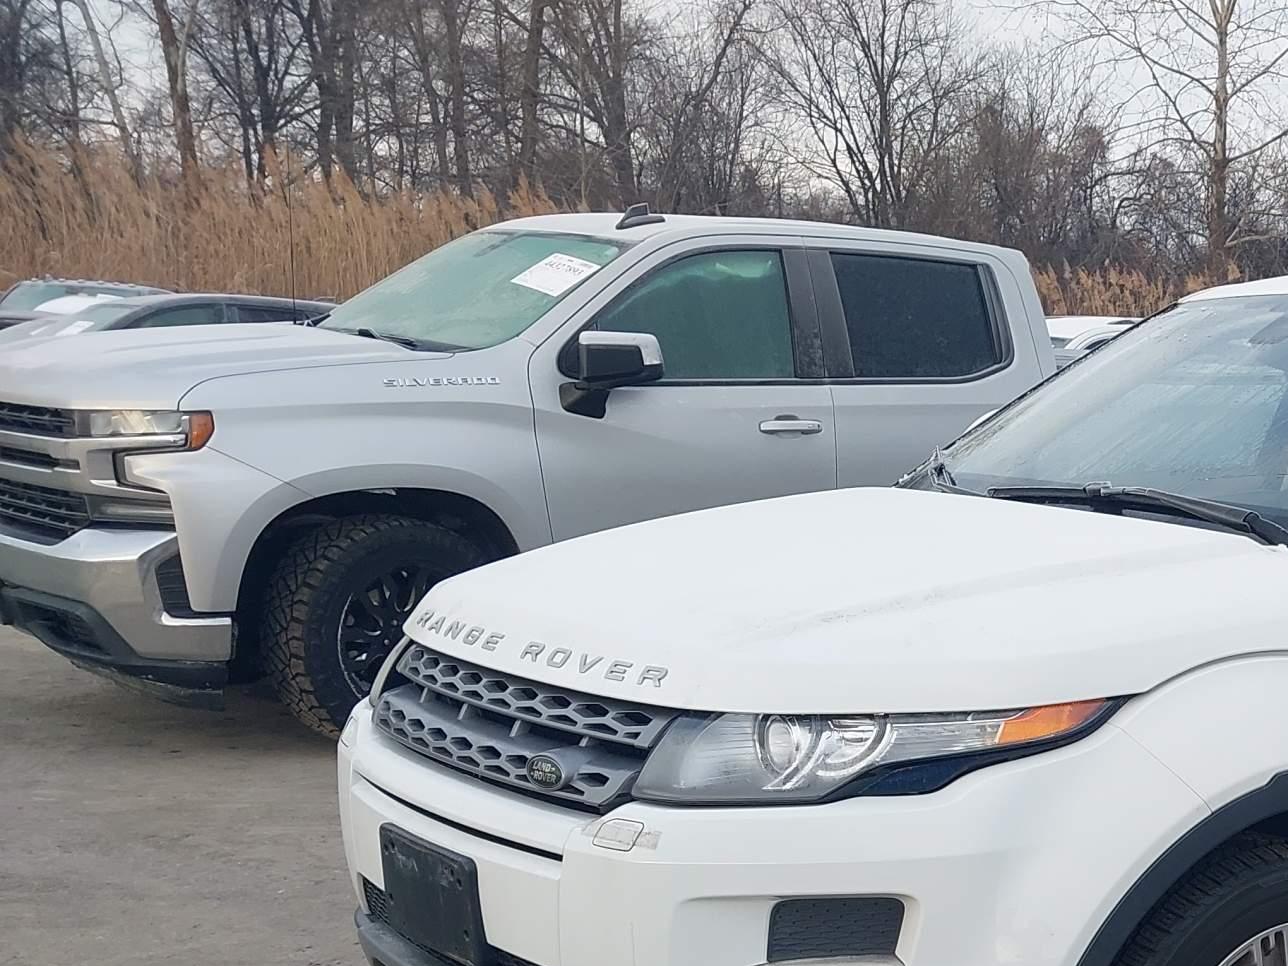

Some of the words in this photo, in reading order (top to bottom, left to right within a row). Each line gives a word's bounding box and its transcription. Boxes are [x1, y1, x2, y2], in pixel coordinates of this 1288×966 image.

[383, 375, 501, 388] SILVERADO
[416, 609, 505, 652] RANGE
[519, 641, 669, 688] ROVER
[533, 770, 557, 785] ROVER
